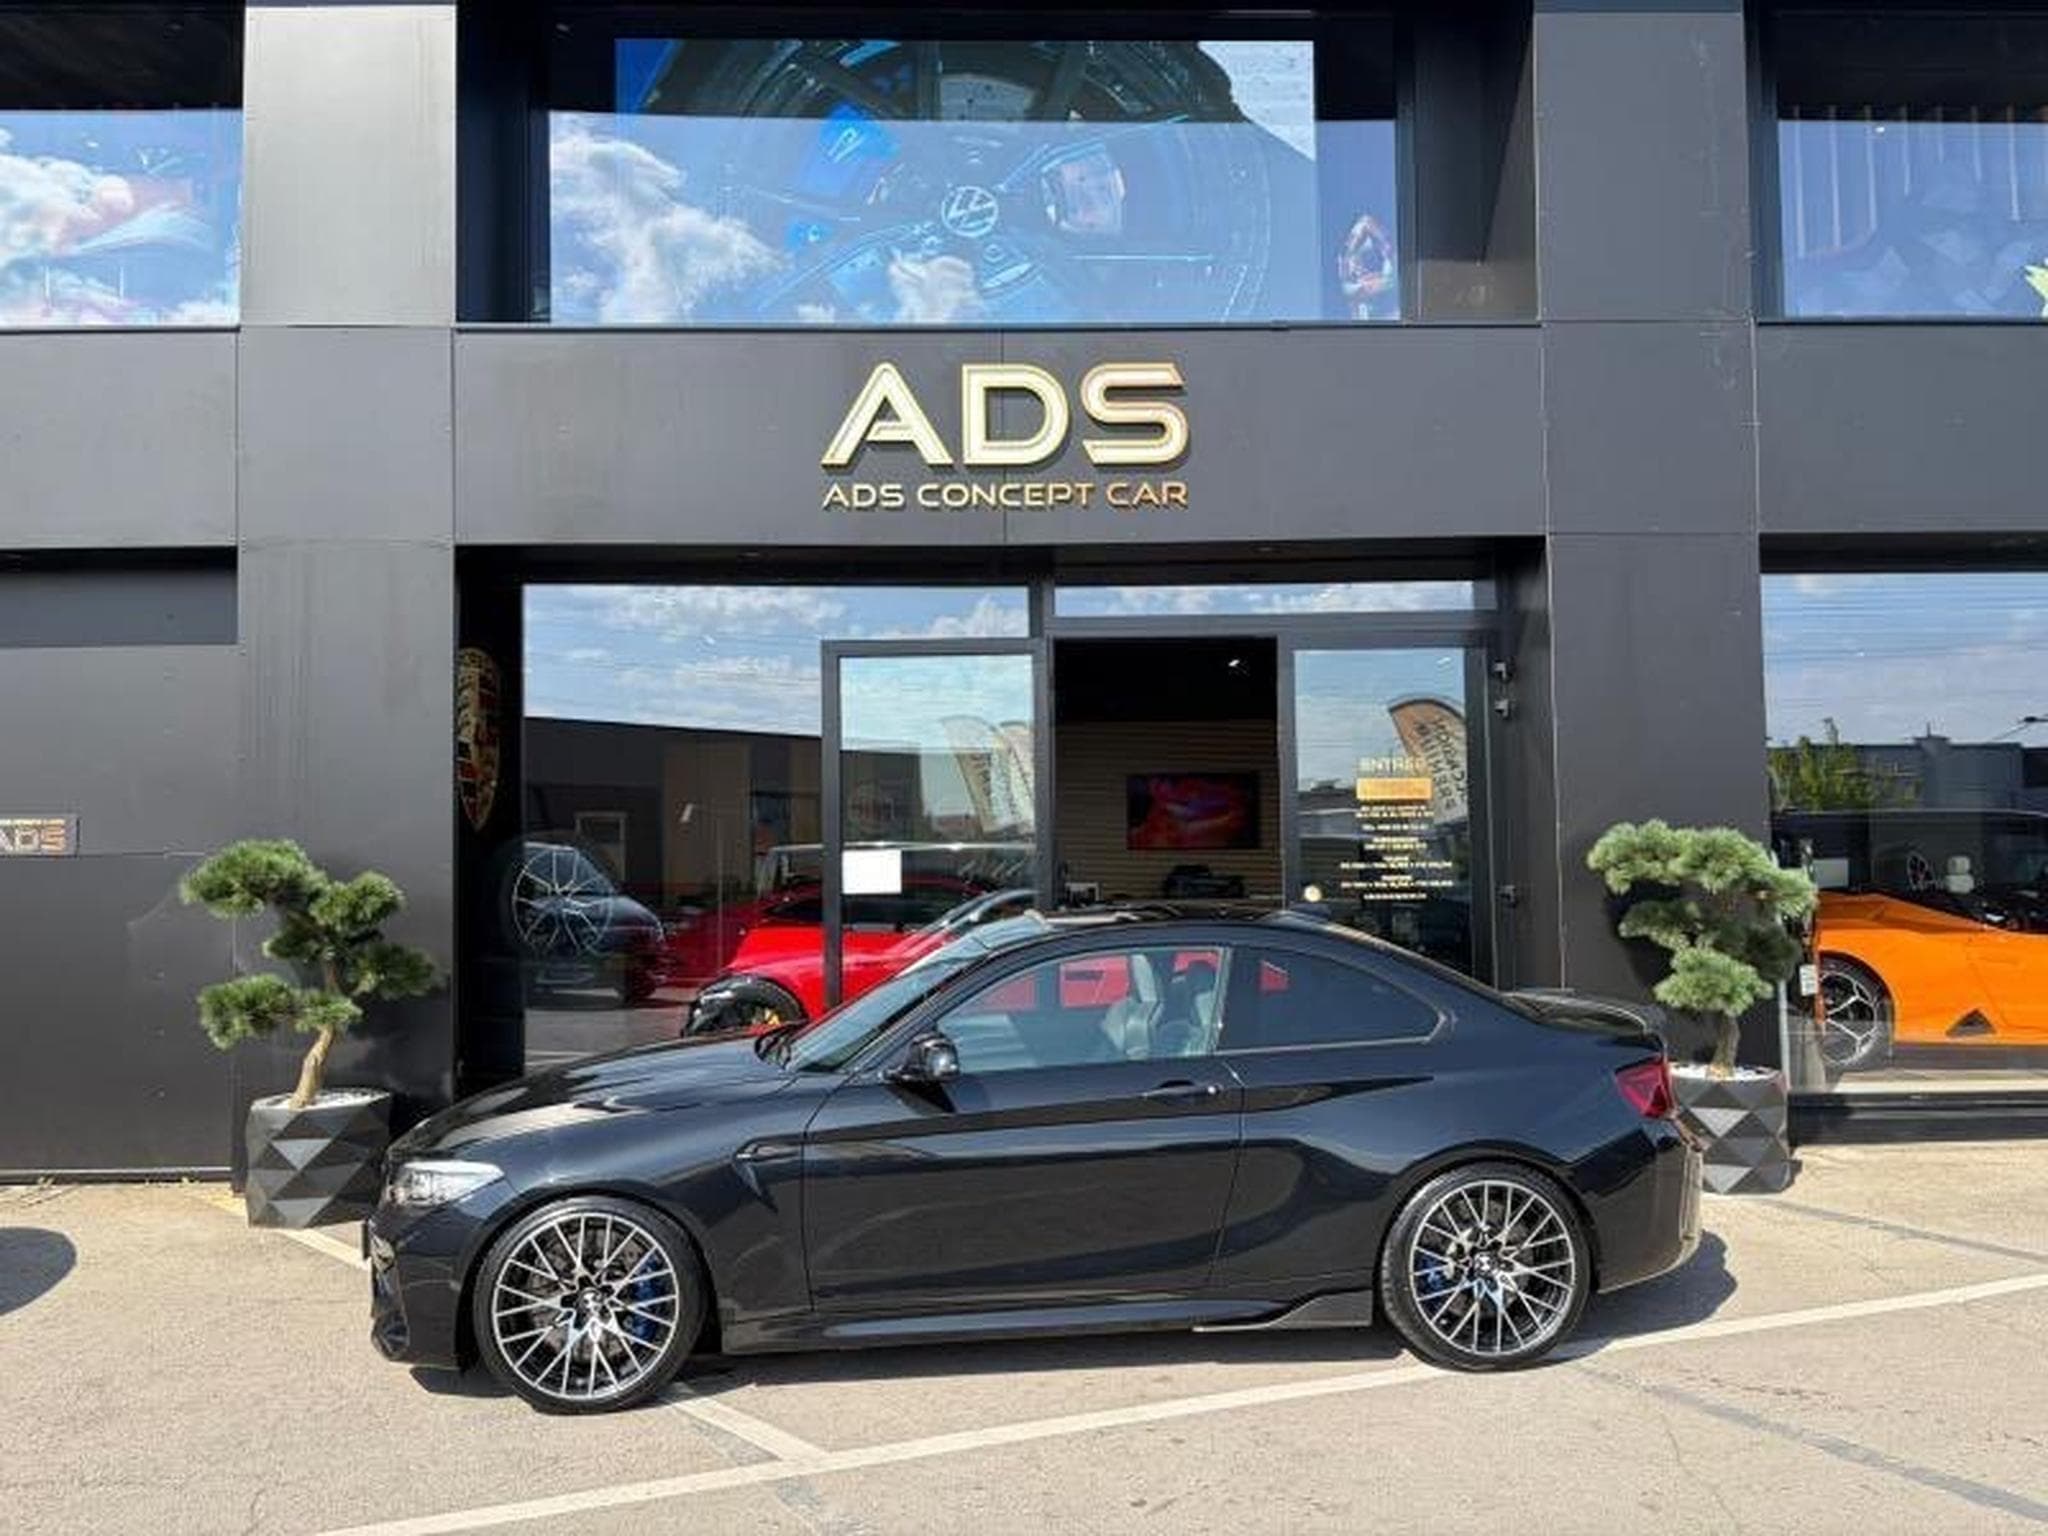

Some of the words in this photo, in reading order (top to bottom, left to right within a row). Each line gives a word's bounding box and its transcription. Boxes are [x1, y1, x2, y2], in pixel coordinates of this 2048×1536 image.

[821, 362, 1189, 466] ADS
[822, 482, 905, 508] ADS
[917, 482, 1094, 508] CONCEPT
[1106, 480, 1188, 506] CAR
